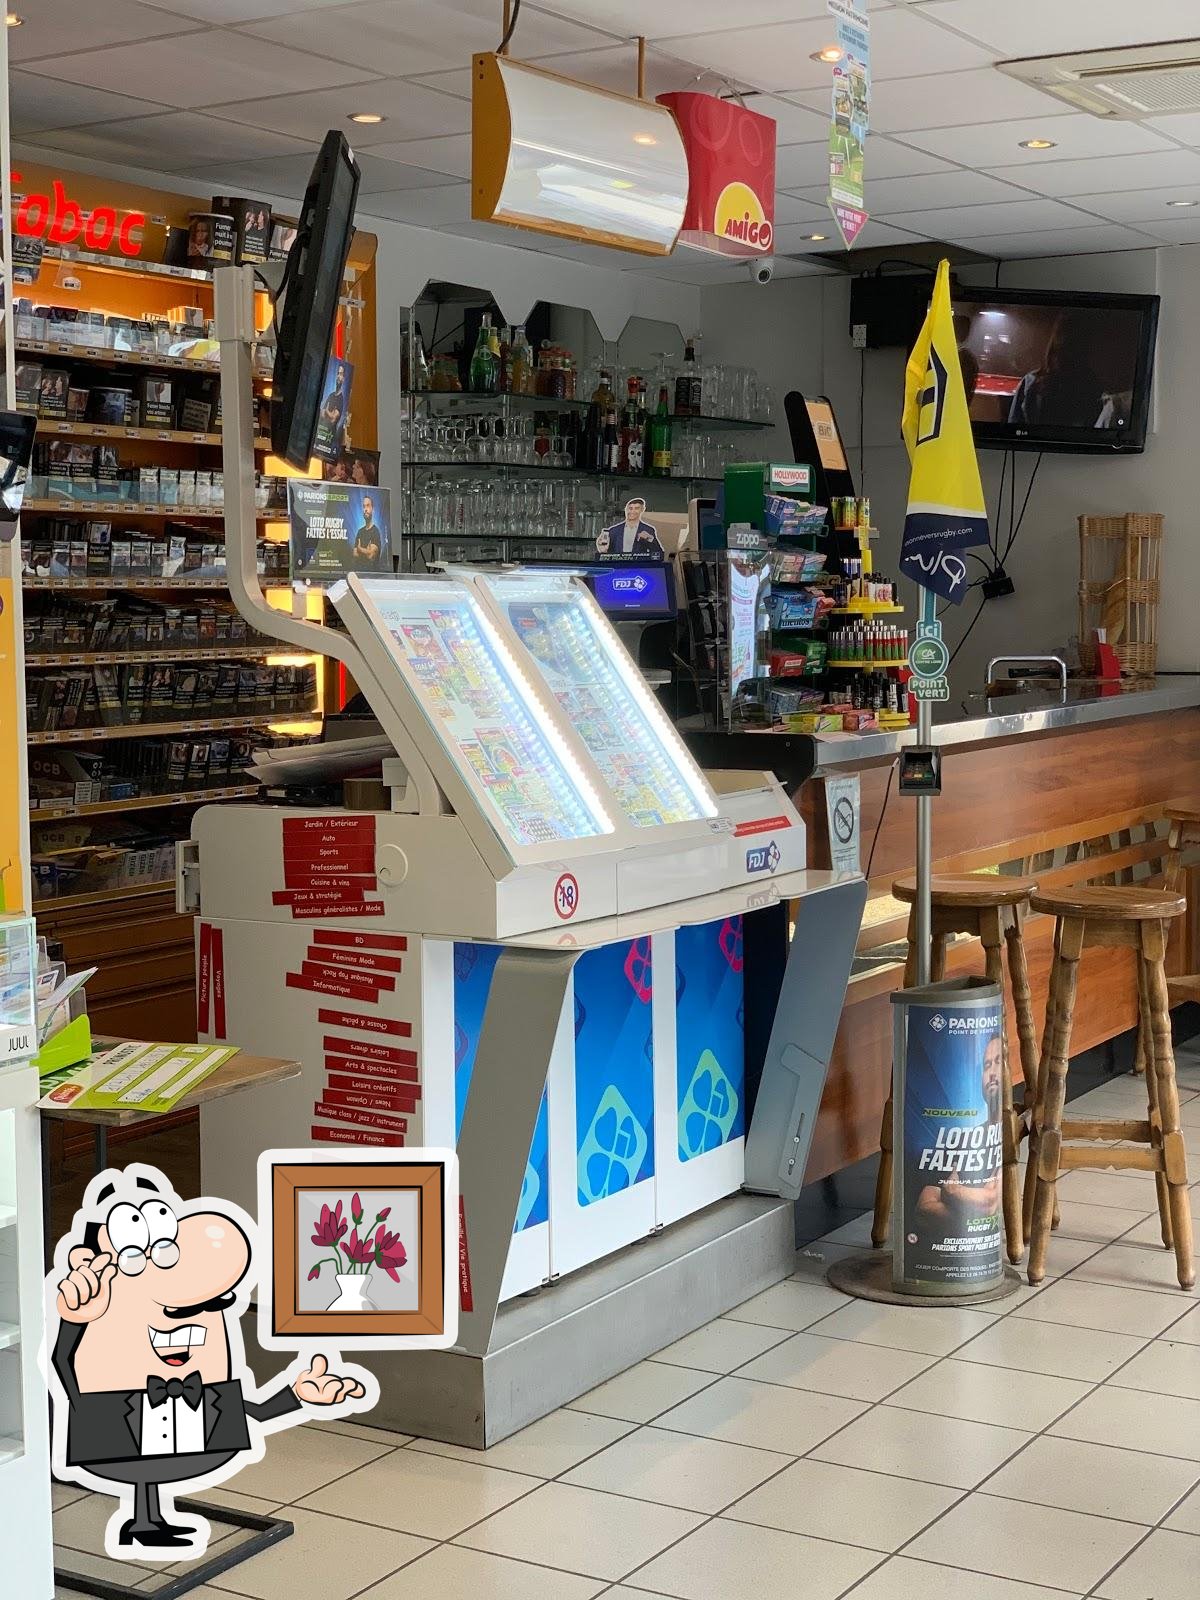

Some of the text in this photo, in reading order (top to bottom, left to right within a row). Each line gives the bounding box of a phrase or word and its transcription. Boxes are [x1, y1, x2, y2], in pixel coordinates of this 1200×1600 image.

[9, 171, 145, 256] abac
[774, 470, 806, 480] HOLLYWOOD
[304, 492, 327, 500] PARIONS
[310, 517, 344, 528] LOTO RUGBY
[306, 528, 326, 539] FAITES
[920, 624, 938, 636] ici
[34, 761, 60, 775] OCB
[748, 852, 765, 869] FDJ
[324, 905, 358, 916] généralistes
[332, 953, 375, 965] Féminins Mode
[322, 969, 374, 984] Musique Pop Rock
[313, 980, 351, 994] Informatique
[342, 1016, 358, 1025] pêche
[367, 1020, 388, 1030] Chasse
[949, 1016, 998, 1028] PARIONS
[9, 1036, 28, 1051] JUUL
[350, 1044, 390, 1057] Loisirs divers
[367, 1064, 397, 1074] spectacles
[352, 1080, 397, 1092] Loisirs créatifs
[346, 1096, 368, 1104] Opinion
[317, 1106, 337, 1115] Musique
[339, 1110, 352, 1118] class
[376, 1118, 404, 1128] instrument
[330, 1130, 355, 1139] Economie
[363, 1134, 385, 1142] Finance
[936, 1127, 984, 1149] LOTO
[918, 1148, 986, 1172] FAITES
[967, 1218, 992, 1226] LOTO
[968, 1224, 991, 1232] RUGBY
